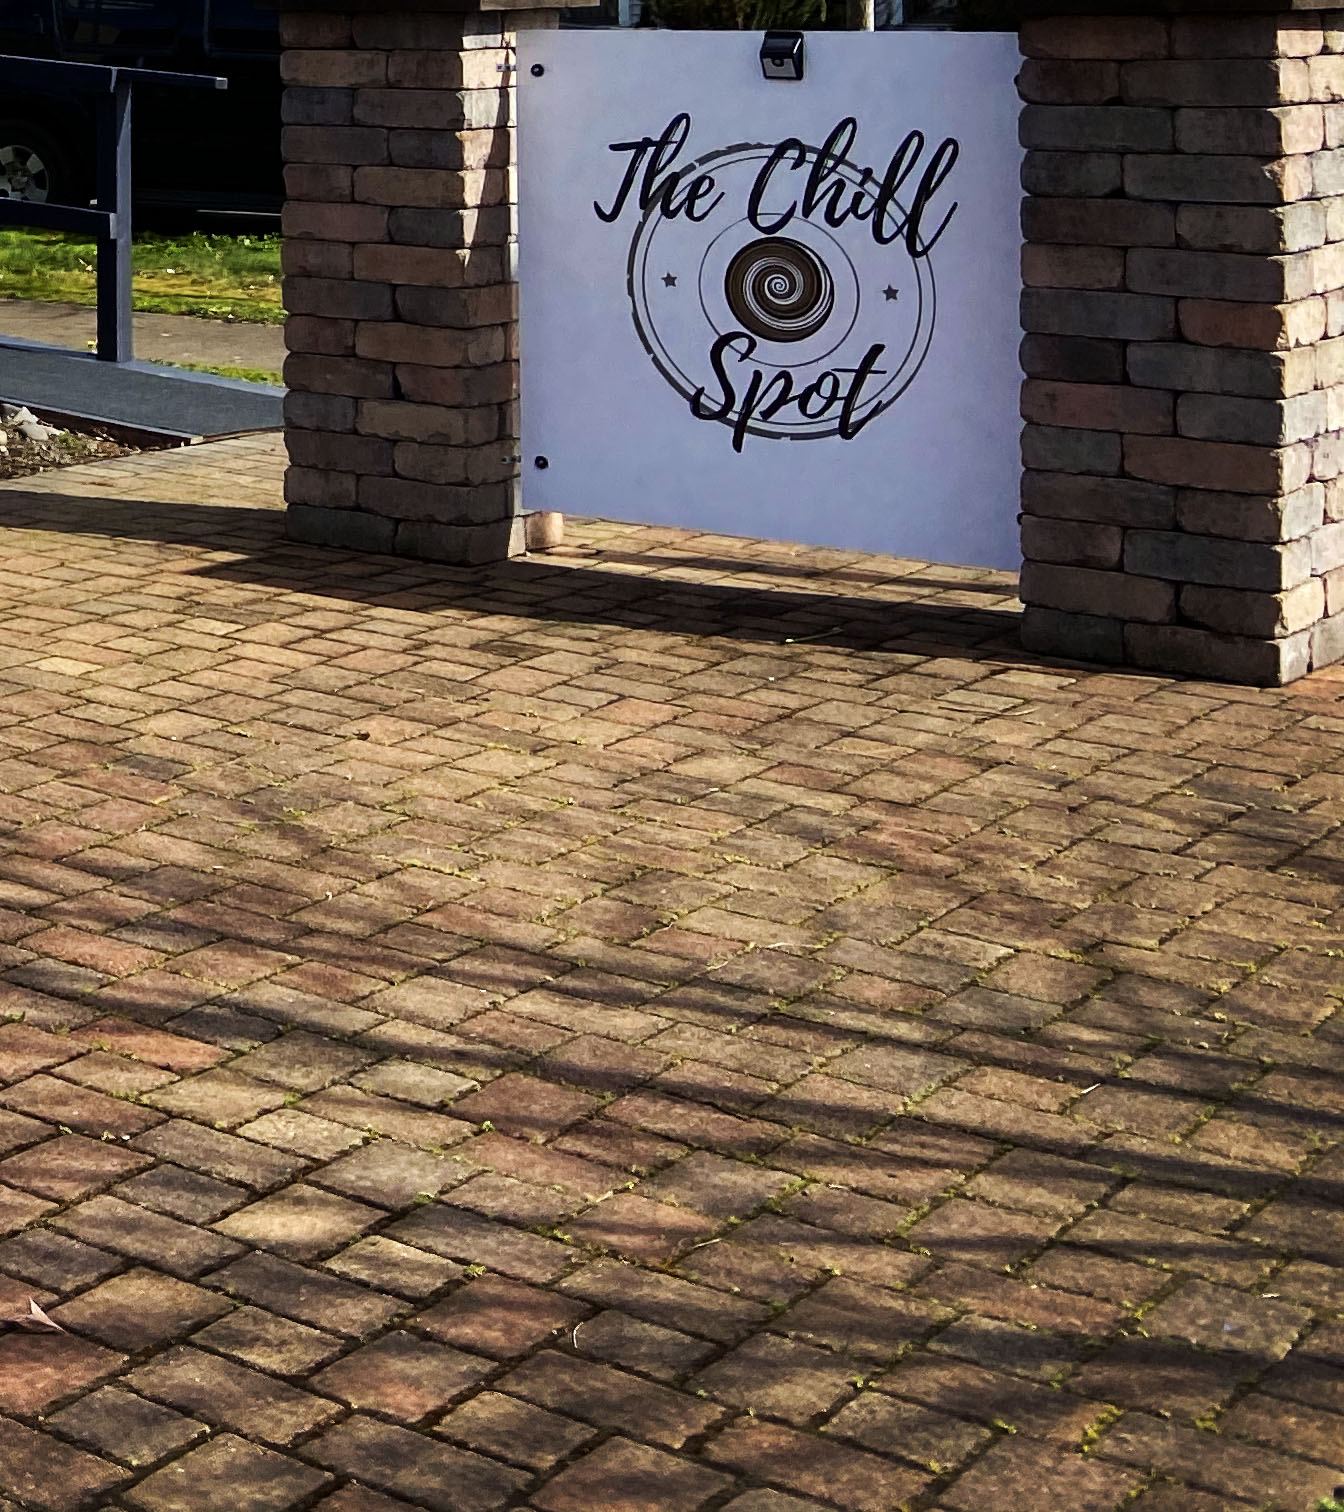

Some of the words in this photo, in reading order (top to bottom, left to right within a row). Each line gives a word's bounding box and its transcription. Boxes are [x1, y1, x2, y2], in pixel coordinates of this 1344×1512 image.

[593, 111, 725, 224] The
[747, 115, 960, 258] Chill
[689, 330, 888, 454] Spot
